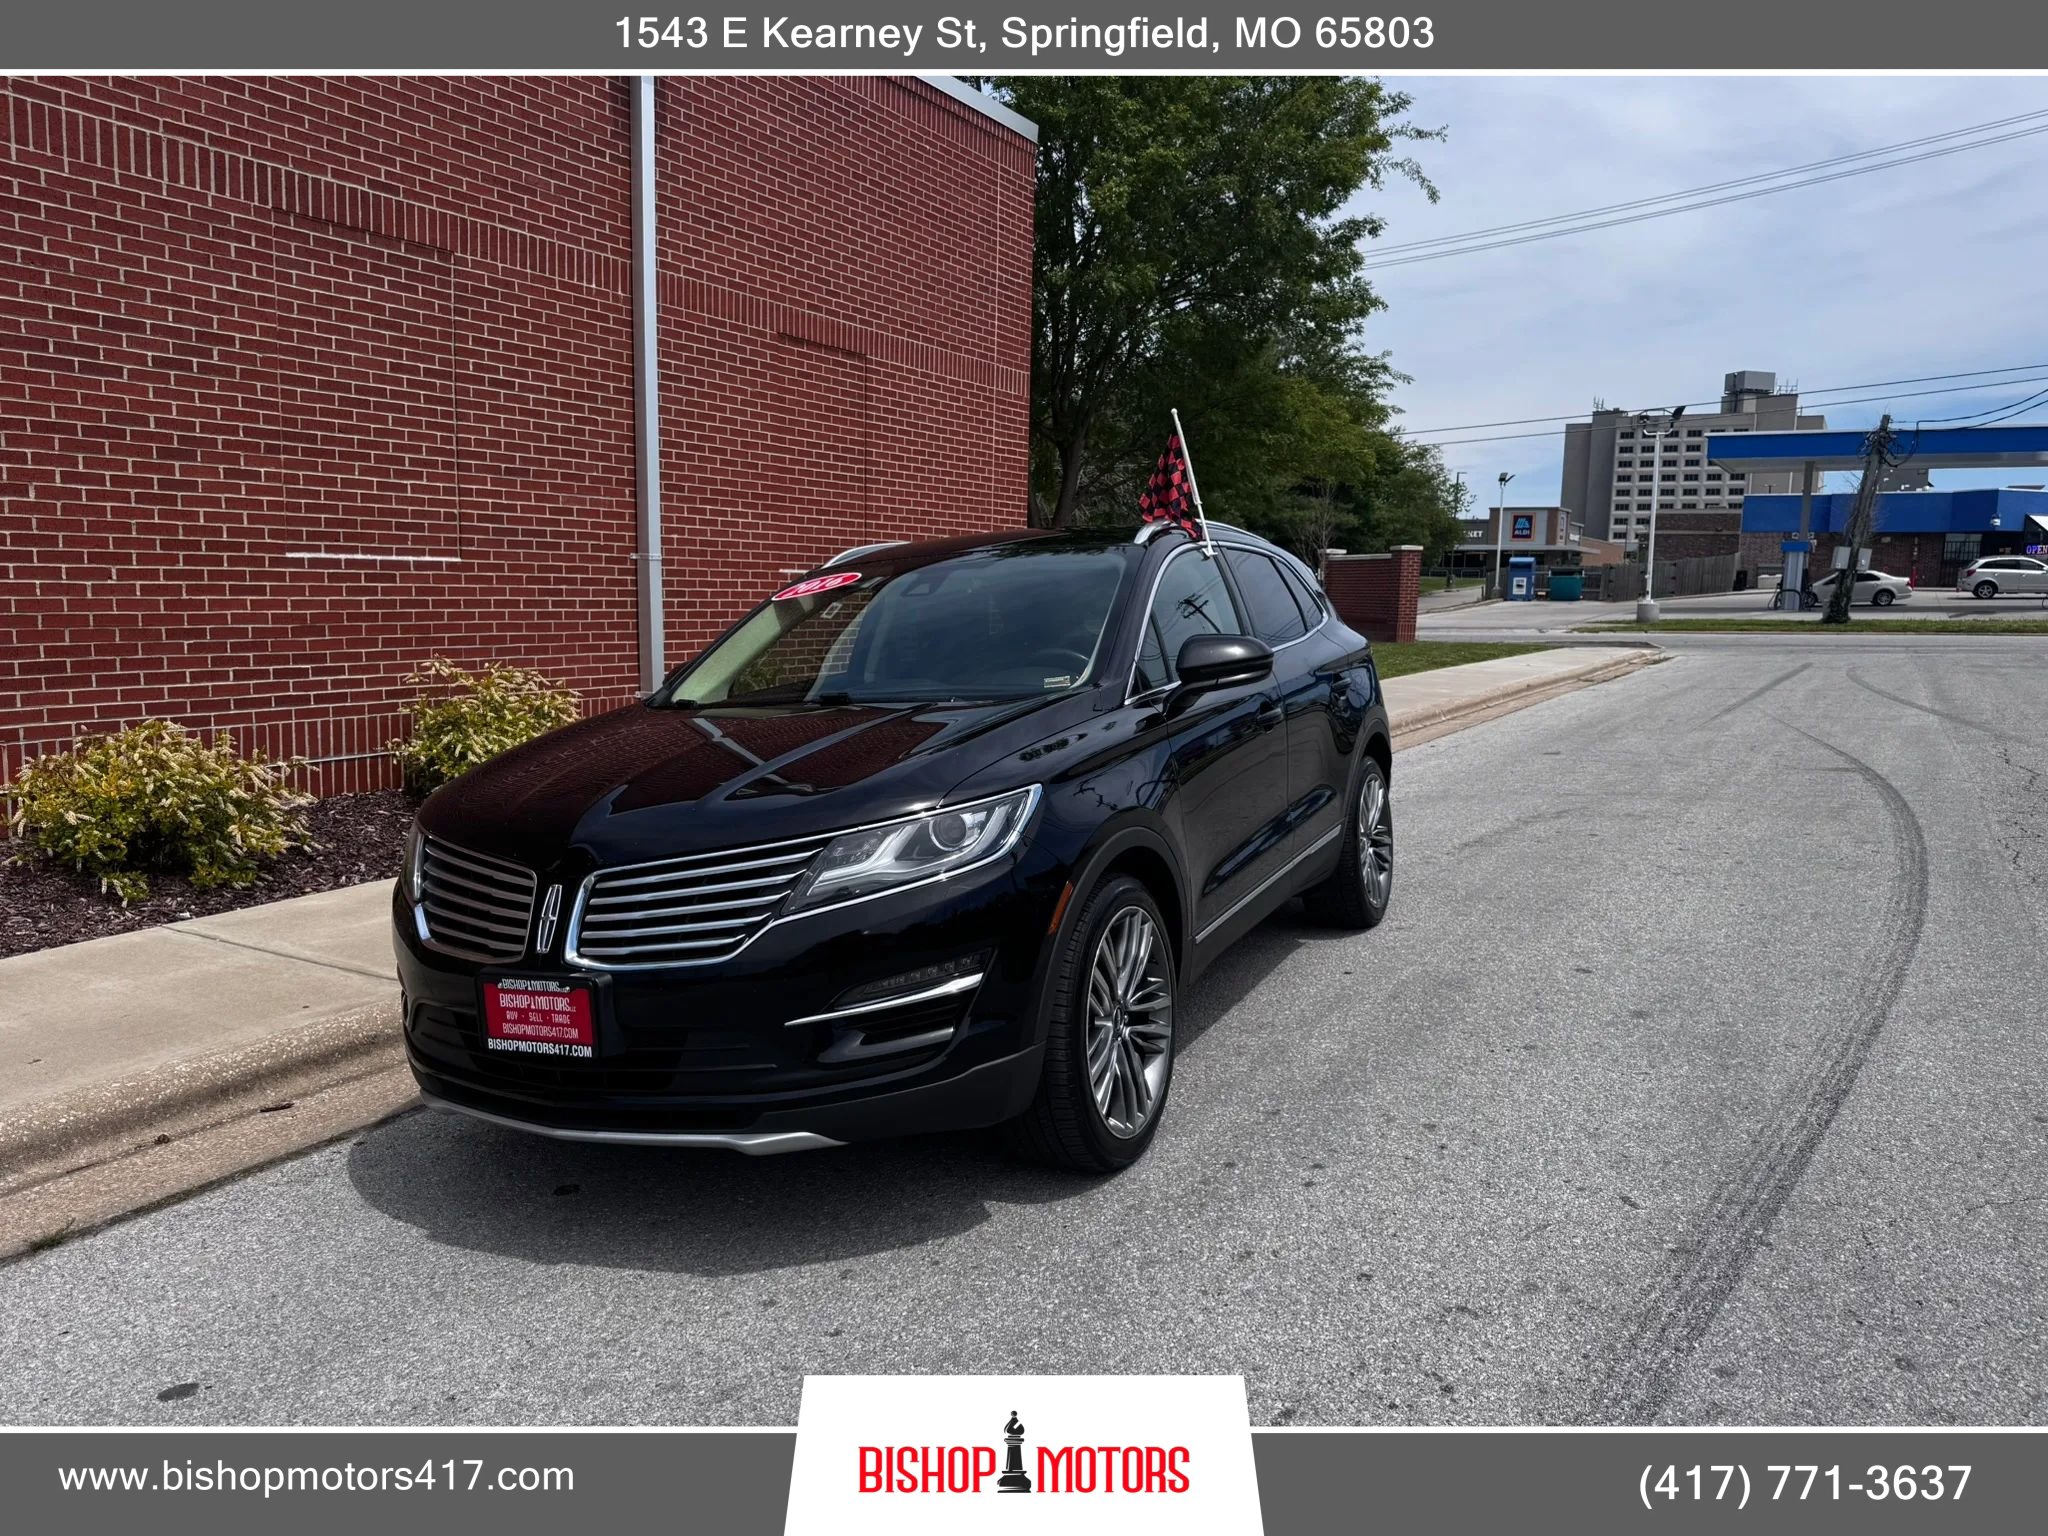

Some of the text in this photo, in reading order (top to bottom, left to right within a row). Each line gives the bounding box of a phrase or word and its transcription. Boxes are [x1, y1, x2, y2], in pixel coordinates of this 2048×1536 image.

[2026, 545, 2048, 554] OPEN
[502, 978, 528, 990] BISHOP
[531, 980, 560, 992] MOTORS
[499, 993, 530, 1009] BISHOP
[535, 996, 570, 1012] MOTORS
[506, 1010, 571, 1025] BUY SELL TRADE
[502, 1022, 579, 1039] BISHOPMOTORS417.COM
[487, 1038, 593, 1058] BISHOPMOTORS417.COM
